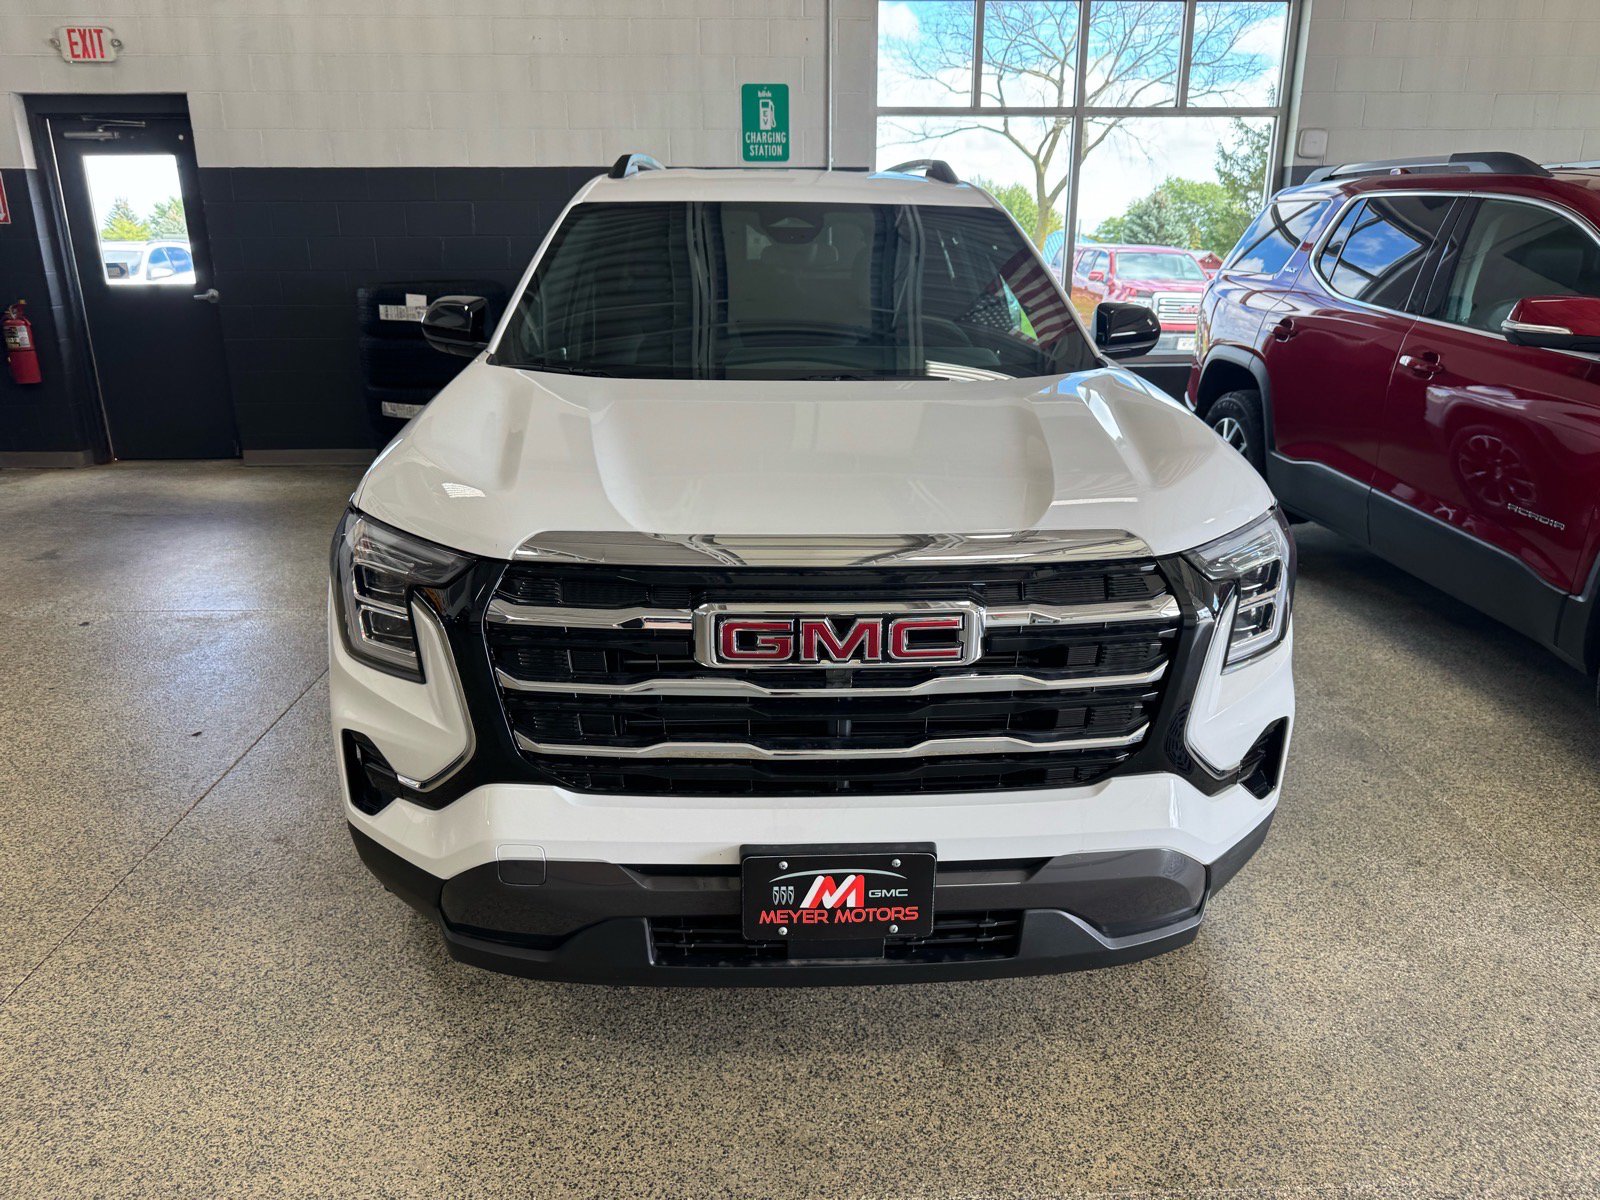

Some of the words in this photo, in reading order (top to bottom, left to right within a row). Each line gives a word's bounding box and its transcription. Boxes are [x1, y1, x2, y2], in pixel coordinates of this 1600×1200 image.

[66, 28, 105, 59] EXIT
[745, 131, 787, 144] CHARGING
[749, 145, 783, 157] STATION
[1507, 503, 1565, 531] ACADIA
[719, 616, 963, 661] GMC
[868, 888, 908, 898] GMC
[759, 909, 829, 925] MEYER
[834, 906, 919, 923] MOTORS
